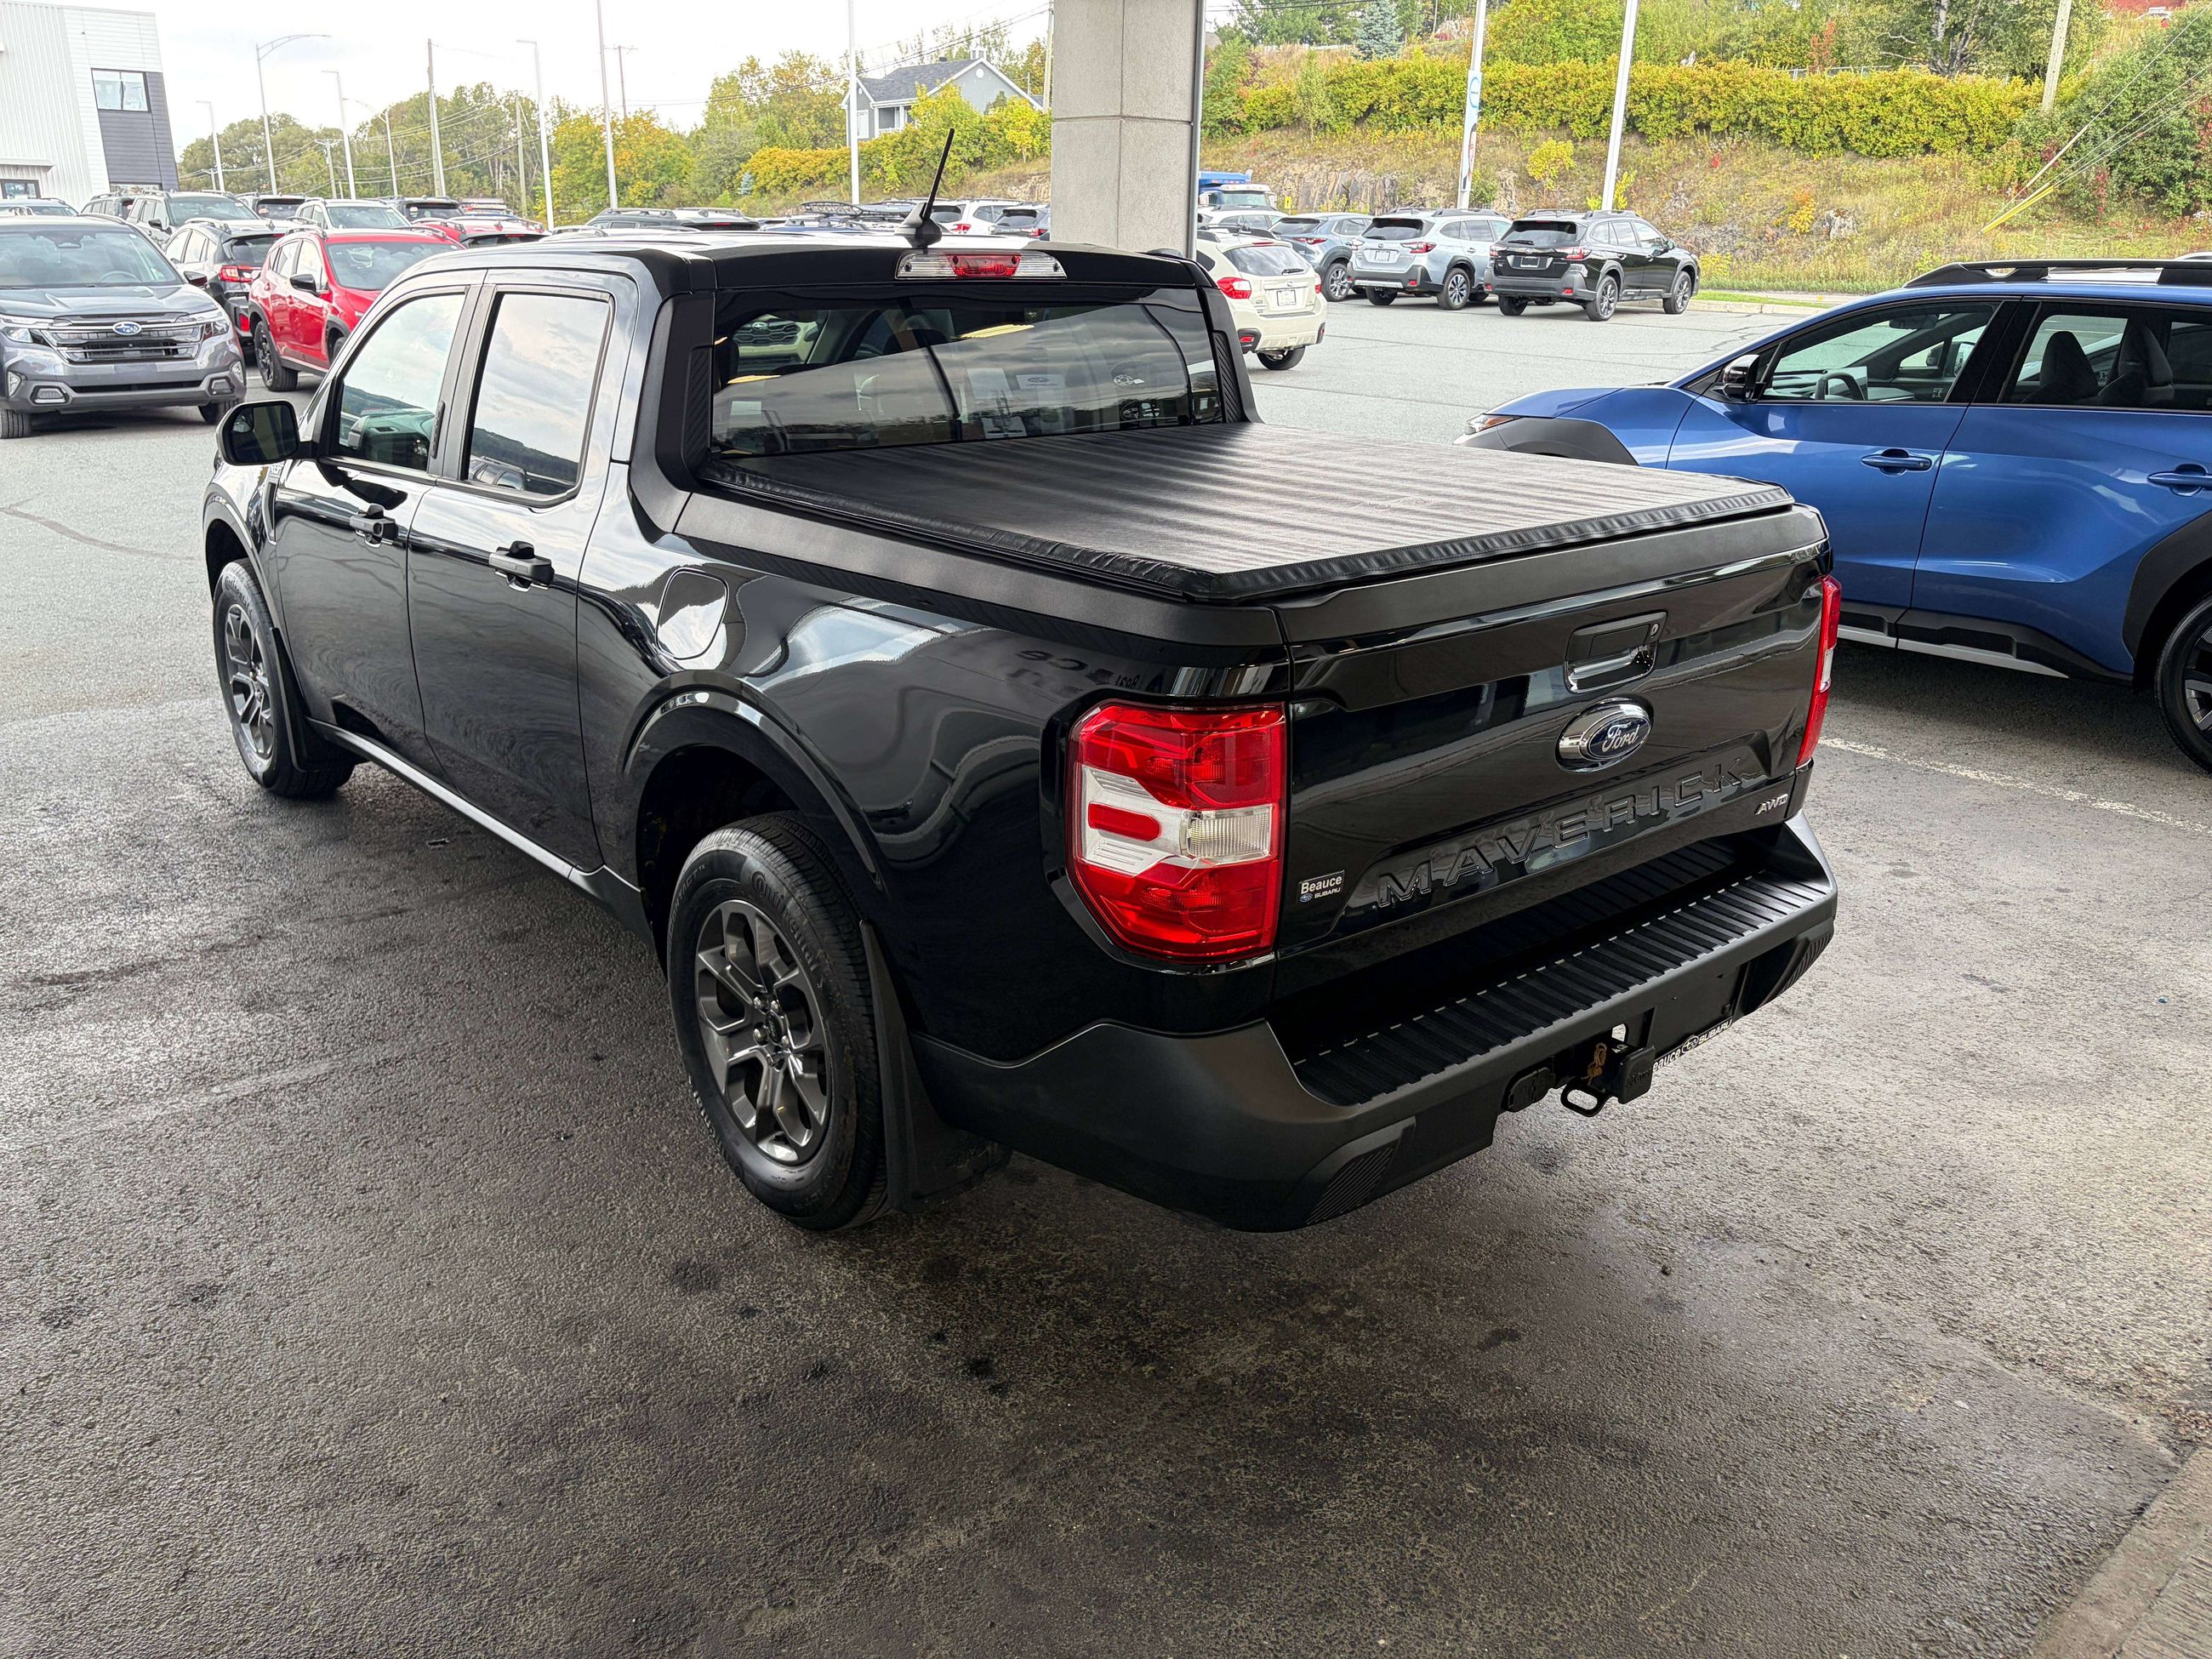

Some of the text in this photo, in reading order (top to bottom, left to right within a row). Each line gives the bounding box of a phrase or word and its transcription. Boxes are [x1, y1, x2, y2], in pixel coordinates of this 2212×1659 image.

[1602, 721, 1640, 752] Ford
[1754, 793, 1788, 815] AWD
[1377, 757, 1742, 908] MAVERICK
[1301, 875, 1342, 894] Beauce
[1314, 887, 1341, 898] SUBARU
[1651, 1018, 1733, 1073] eauce SUBARU
